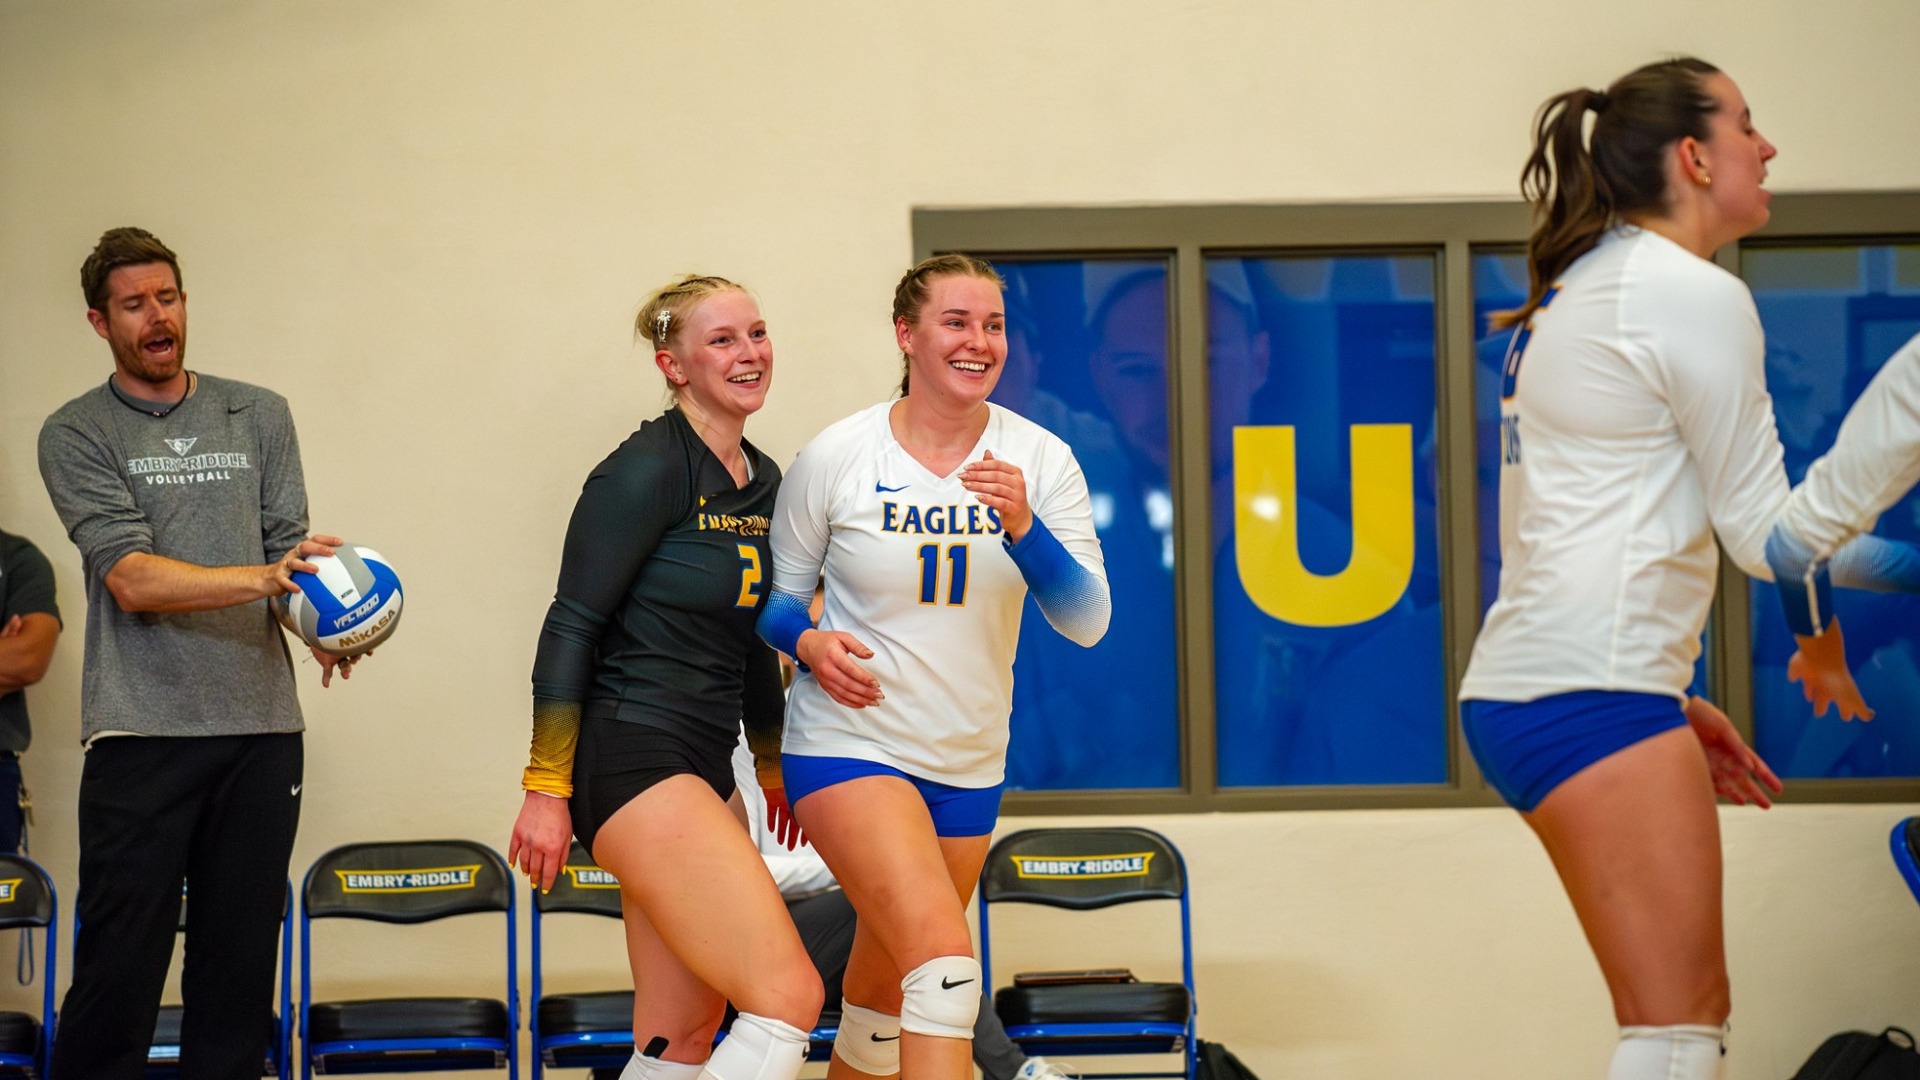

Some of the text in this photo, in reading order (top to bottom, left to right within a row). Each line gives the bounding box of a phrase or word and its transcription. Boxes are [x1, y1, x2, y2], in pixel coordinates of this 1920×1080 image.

[145, 470, 232, 485] VOLLEYBALL
[880, 500, 1004, 535] EAGLES
[1233, 423, 1415, 628] U
[734, 541, 763, 610] 2
[916, 541, 970, 607] 11
[347, 870, 471, 888] EMBRY-RIDDLE
[1022, 857, 1143, 875] EMBRY-RIDDLE
